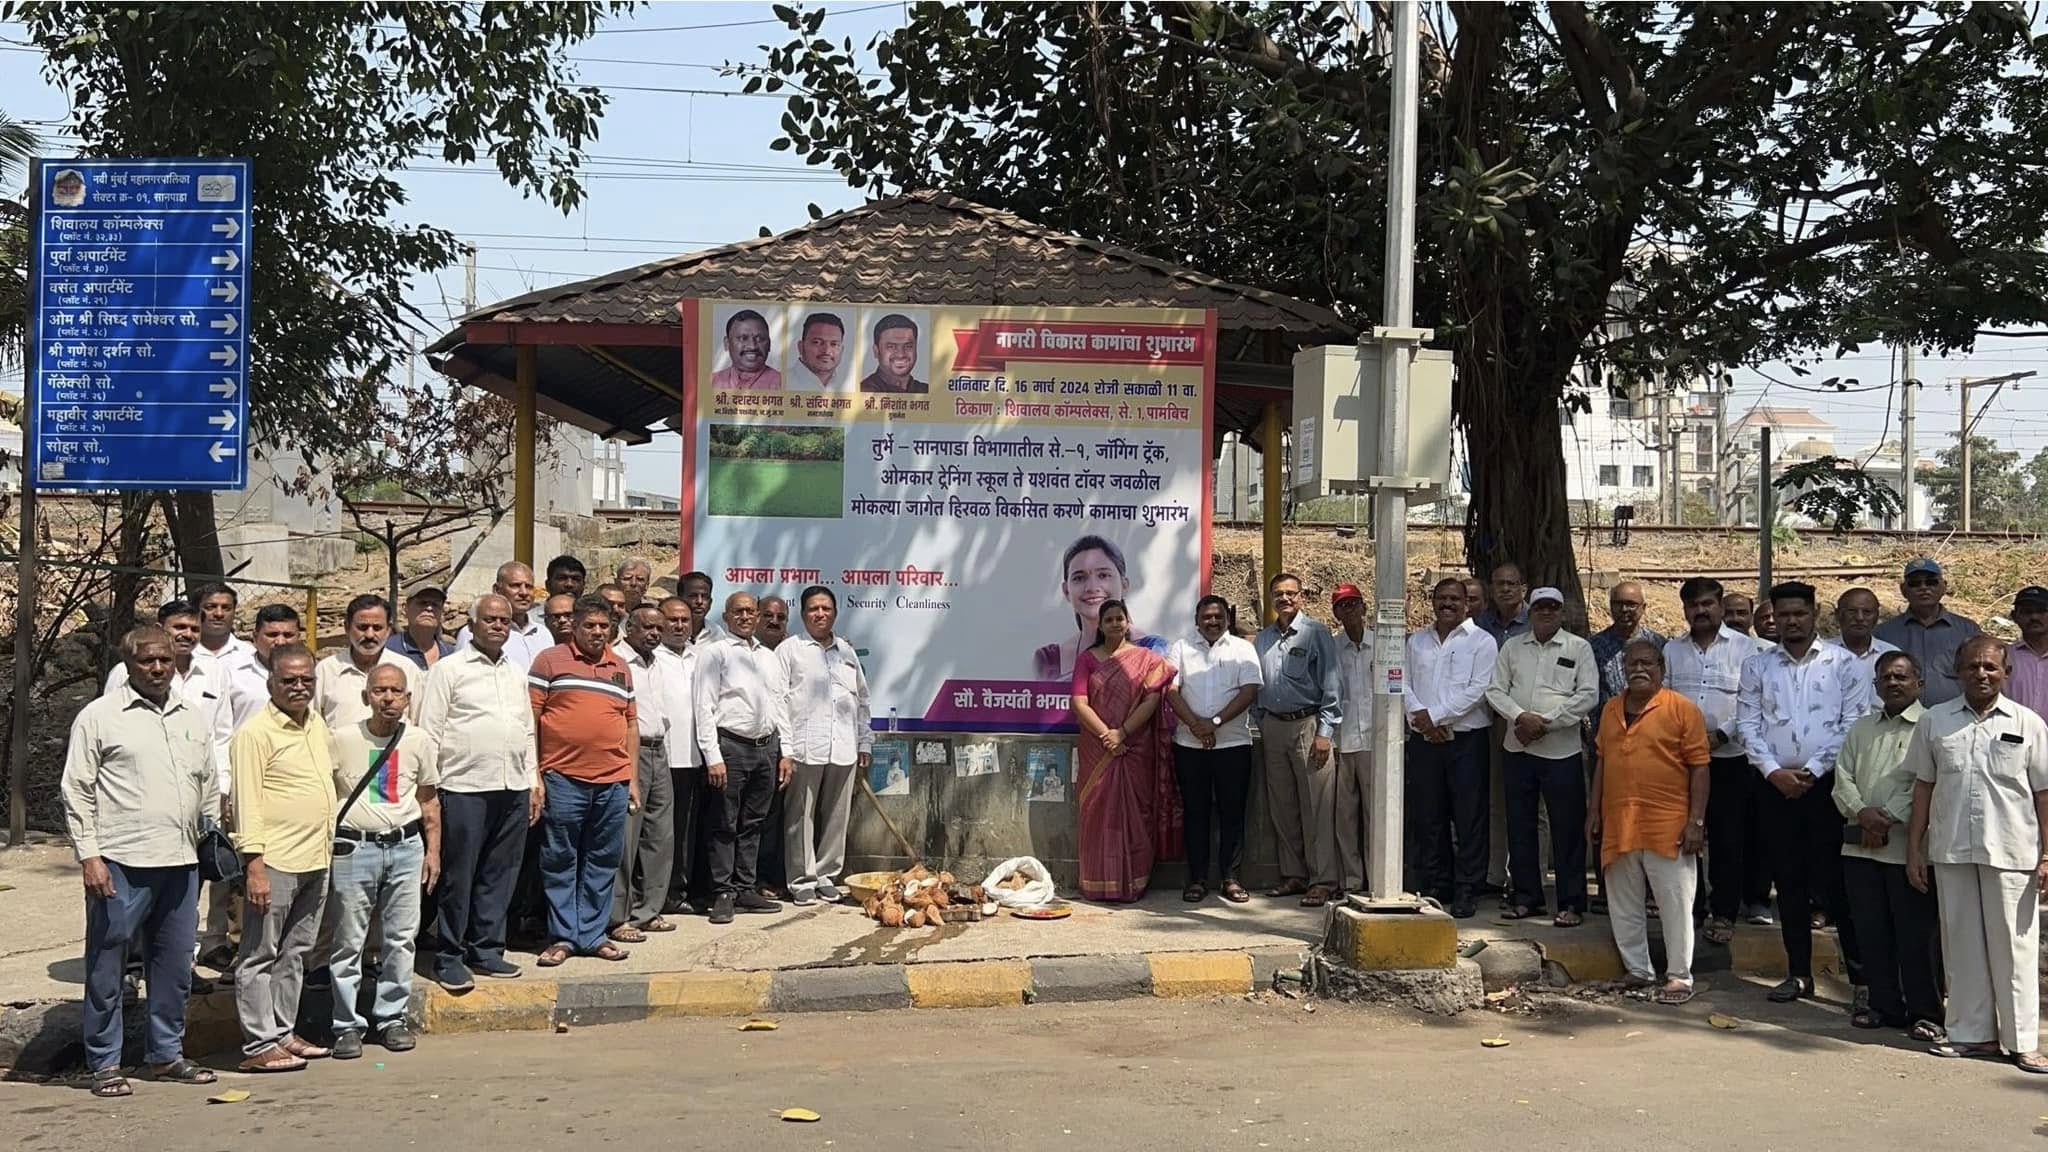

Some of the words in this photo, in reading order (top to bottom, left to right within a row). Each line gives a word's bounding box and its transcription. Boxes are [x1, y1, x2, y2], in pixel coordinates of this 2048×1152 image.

[92, 172, 107, 184] नवी
[111, 171, 128, 188] मुंबई
[130, 172, 191, 186] महानगरपालिका
[92, 190, 116, 202] सेक्टर
[153, 192, 188, 202] सानपाडा
[51, 216, 98, 231] शिवालय
[103, 215, 164, 231] कॉम्पलेक्स
[50, 247, 73, 266] पुर्वा
[76, 247, 127, 262] अपार्टमेंट
[49, 280, 78, 294] वसंत
[83, 280, 134, 294] अपार्टमेंट
[49, 311, 74, 326] ओम
[79, 310, 93, 326] श्री
[133, 312, 175, 327] रामेश्वर
[181, 312, 200, 327] सो.
[48, 342, 62, 357] श्री
[67, 343, 98, 357] गणेश
[103, 344, 131, 358] दर्शन
[136, 343, 156, 357] सो.
[995, 326, 1037, 349] नागरी
[1041, 328, 1087, 350] विकास
[1091, 328, 1141, 351] कामांचा
[1145, 330, 1196, 358] शुभारंभ
[47, 374, 91, 389] गॅलेक्सी
[96, 375, 115, 389] सो.
[948, 375, 990, 392] शनिवार
[994, 376, 1009, 393] दि.
[1015, 380, 1027, 392] 16
[1032, 378, 1055, 393] मार्च
[1060, 381, 1090, 394] 2024
[1094, 378, 1119, 396] रोजी
[1123, 380, 1162, 397] सकाळी
[1167, 384, 1177, 397] 11
[1182, 385, 1197, 398] वा.
[715, 391, 729, 406] श्री.
[731, 394, 761, 406] दशरथ
[762, 395, 784, 406] भगत
[790, 395, 803, 409] श्री.
[806, 395, 829, 409] संदिप
[831, 398, 851, 409] भगत
[864, 396, 878, 410] श्री.
[881, 397, 907, 410] निशांत
[909, 400, 930, 411] भगत
[47, 406, 87, 422] महावीर
[92, 407, 143, 421] अपार्टमेंट
[955, 397, 993, 416] ठिकाण
[1004, 398, 1050, 418] शिवालय
[1055, 400, 1113, 421] कॉम्पलेक्स,
[1118, 402, 1132, 420] से.
[46, 438, 78, 453] सोहम
[83, 438, 102, 453] सो.
[872, 433, 895, 461] तुर्भे
[913, 439, 968, 457] सानपाडा
[973, 436, 1045, 458] विभागातील
[1096, 439, 1139, 461] जॉगिंग
[881, 468, 934, 486] ओमकार
[937, 465, 972, 488] ट्रेनिंग
[976, 472, 1007, 493] स्कूल
[1012, 466, 1024, 487] ते
[1028, 467, 1070, 489] यशवंत
[1074, 470, 1105, 489] टॉवर
[1109, 471, 1161, 491] जवळील
[851, 497, 902, 517] मोकल्या
[906, 497, 944, 517] जागेत
[948, 497, 991, 518] हिरवळ
[996, 497, 1048, 518] विकसित
[1053, 498, 1085, 519] करणे
[1089, 504, 1138, 520] कामाचा
[1142, 499, 1189, 526] शुभारंभ
[725, 567, 774, 583] आपला
[841, 569, 890, 586] आपला
[847, 595, 887, 611] Security
[896, 595, 950, 610] Cleanliness
[953, 687, 978, 708] सौ.
[983, 688, 1031, 709] वैजयंती
[1036, 693, 1071, 711] भगत
